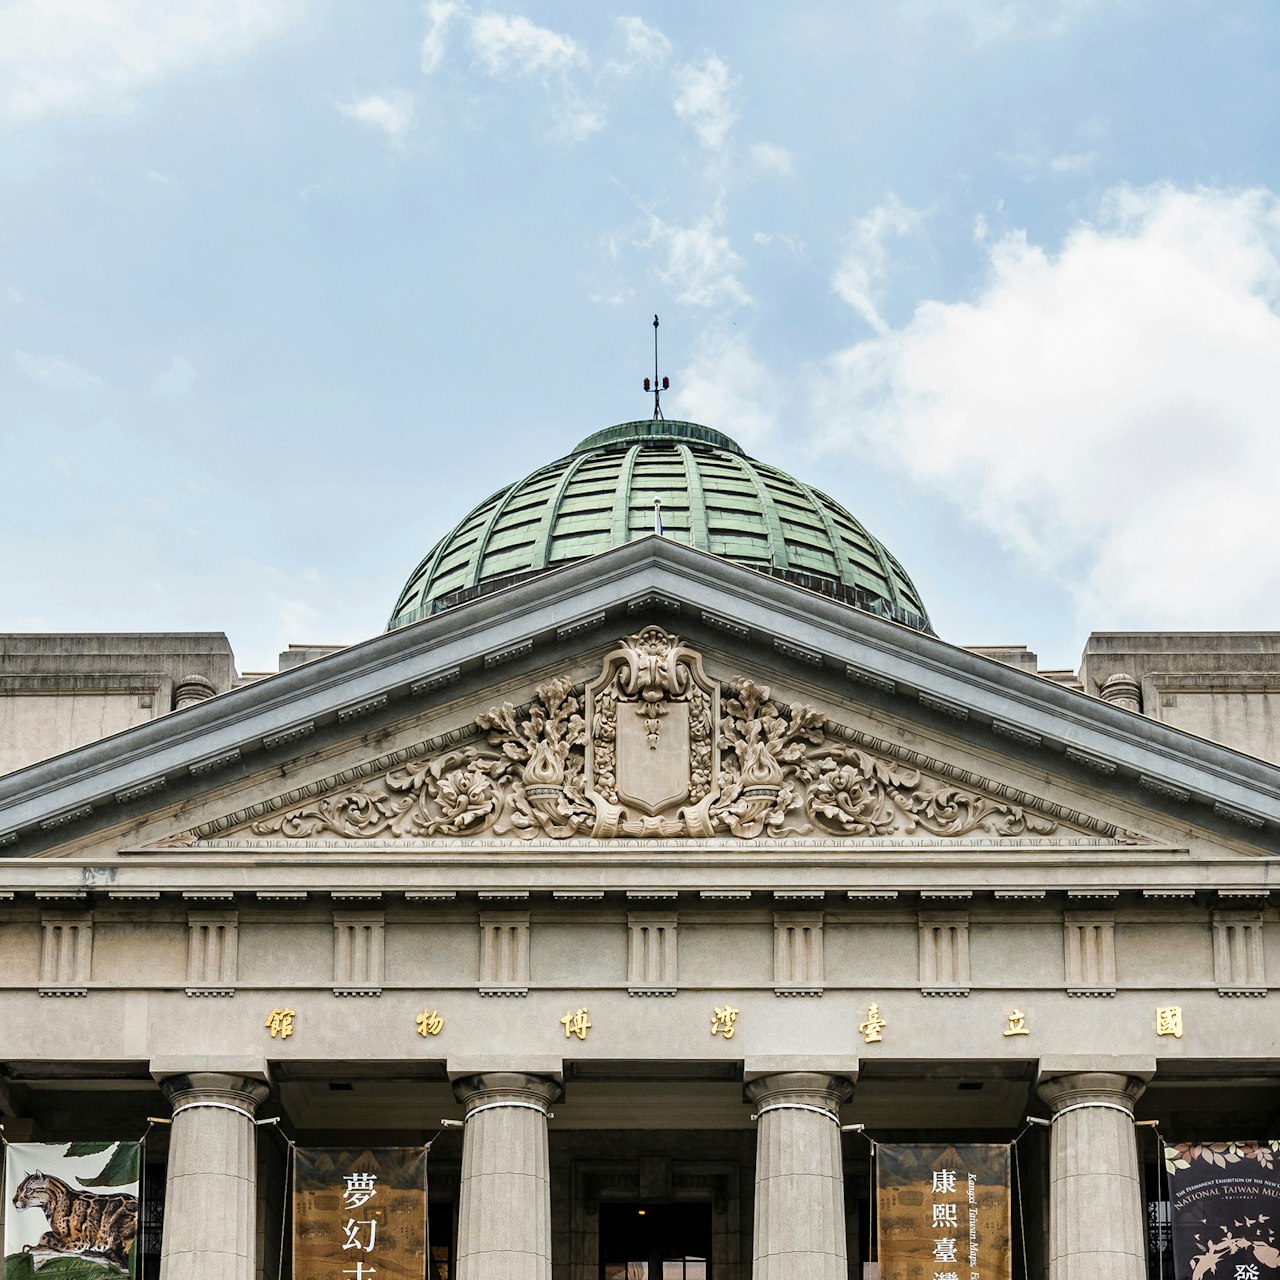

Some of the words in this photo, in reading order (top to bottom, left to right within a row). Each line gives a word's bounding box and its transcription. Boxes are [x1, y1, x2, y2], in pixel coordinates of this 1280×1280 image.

[967, 1172, 977, 1205] Kangxi
[1174, 1187, 1220, 1211] NATIONAL
[1222, 1185, 1259, 1194] TAIWAN
[1185, 1180, 1215, 1192] PERMANENT
[1215, 1177, 1245, 1185] EXHIBITION
[968, 1207, 979, 1240] Taiwan
